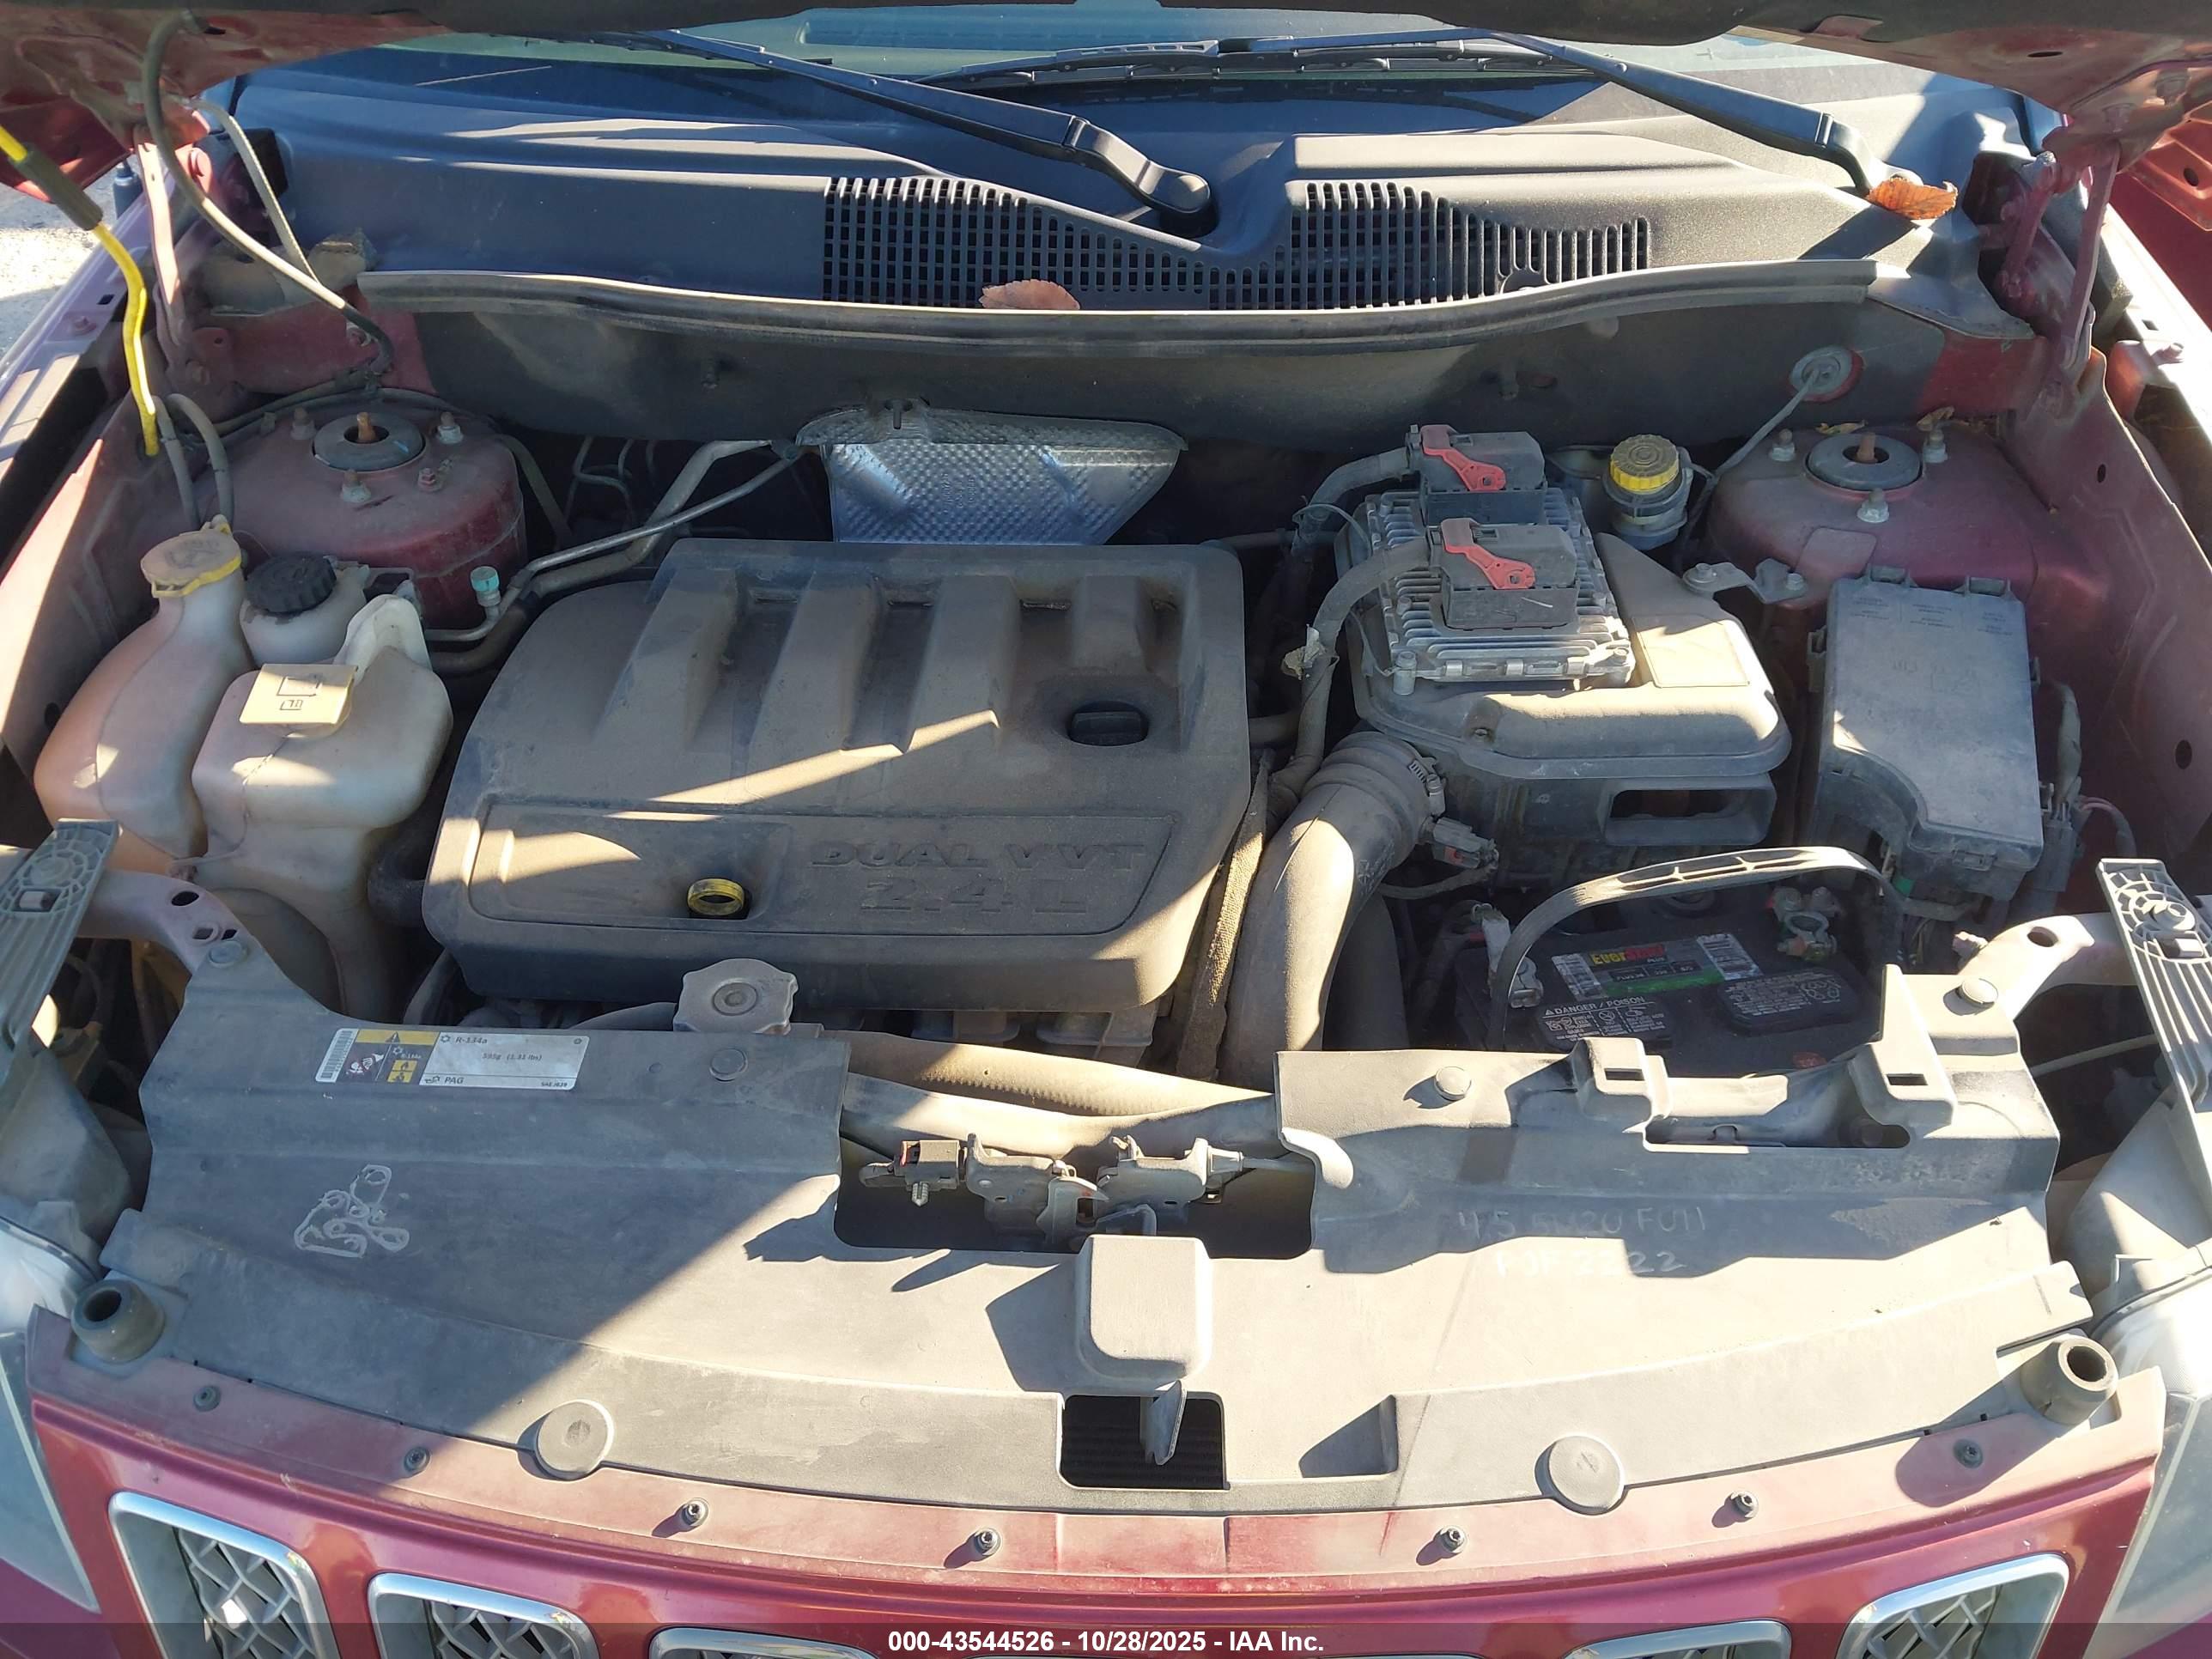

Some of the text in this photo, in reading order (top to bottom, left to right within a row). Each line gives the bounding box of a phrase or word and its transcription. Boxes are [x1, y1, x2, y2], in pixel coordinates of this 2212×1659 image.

[808, 842, 1146, 870] DUAL VVT
[1553, 1002, 1597, 1015] DANGER
[1606, 995, 1645, 1008] POISON
[444, 1076, 464, 1085] PAG
